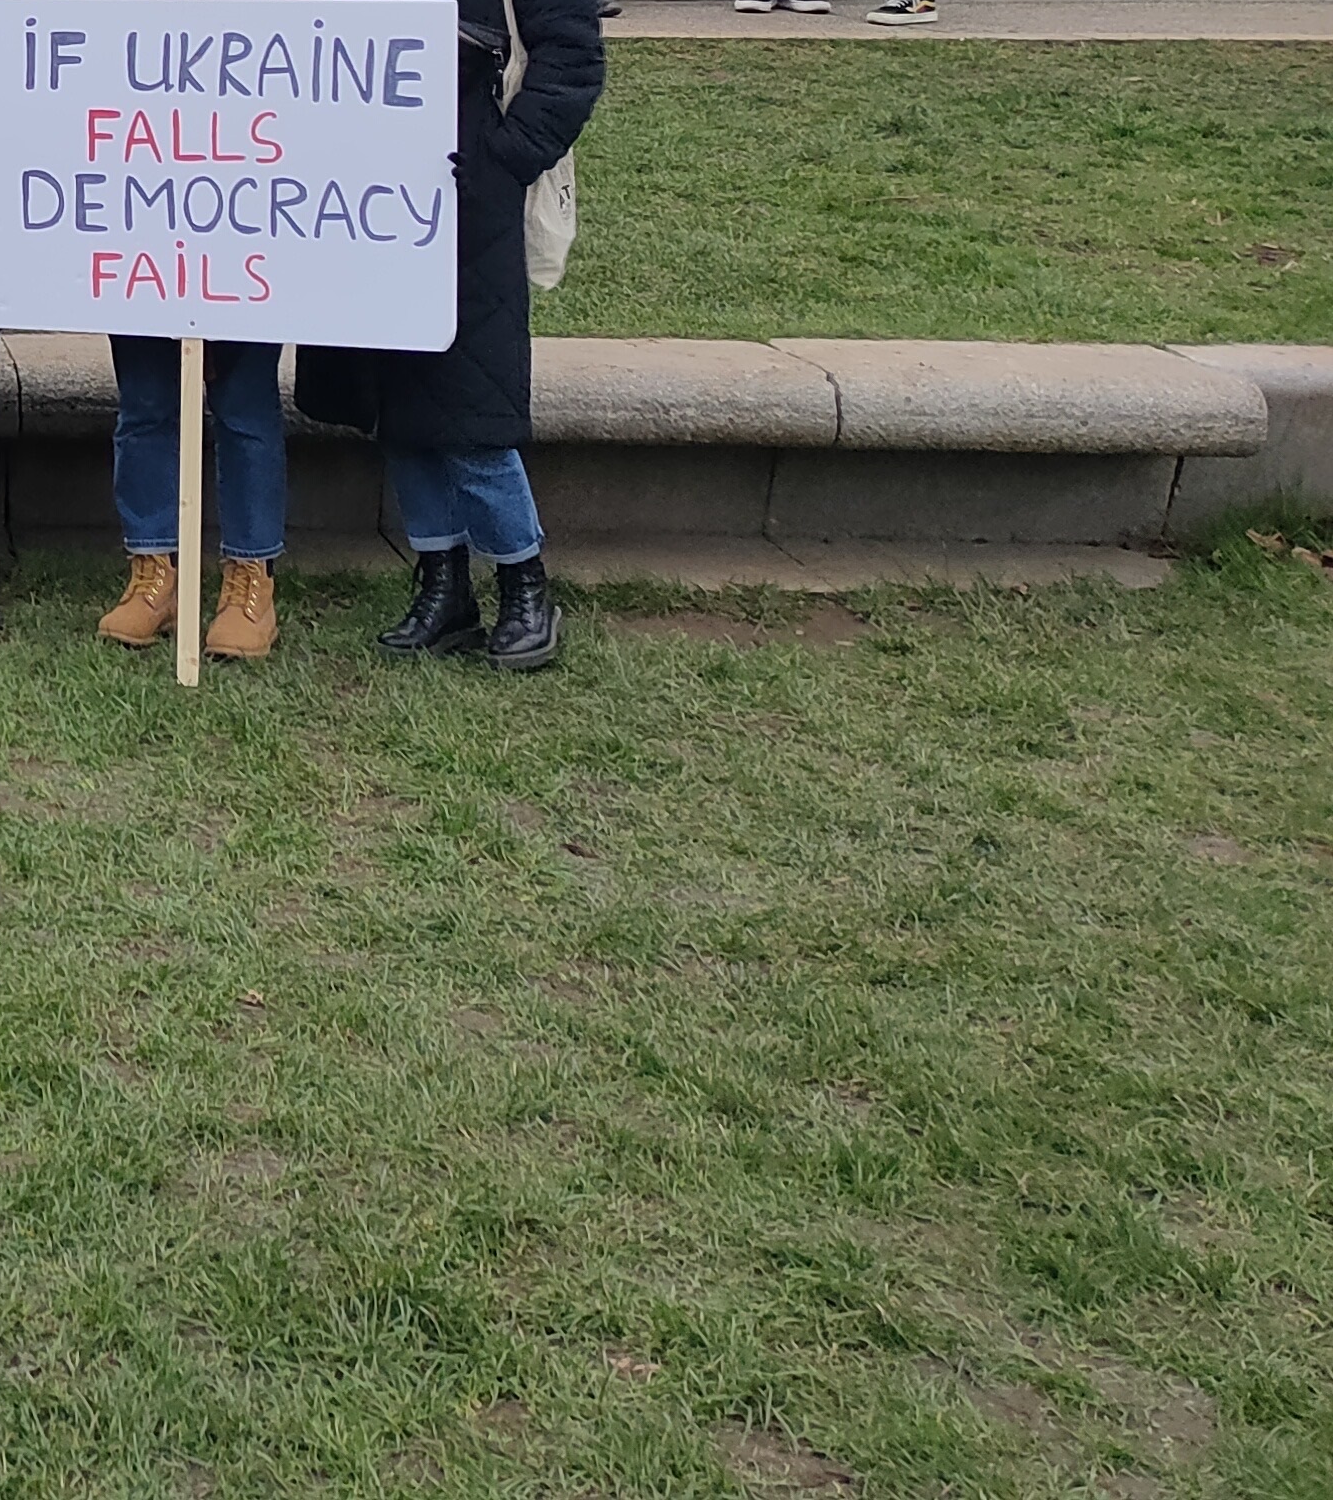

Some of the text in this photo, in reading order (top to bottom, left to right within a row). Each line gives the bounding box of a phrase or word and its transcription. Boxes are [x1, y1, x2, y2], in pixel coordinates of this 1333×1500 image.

[25, 17, 425, 107] IF UKRAINE
[88, 108, 284, 164] FALLS
[21, 169, 443, 247] DEMOCRACY
[92, 240, 271, 303] FAILS
